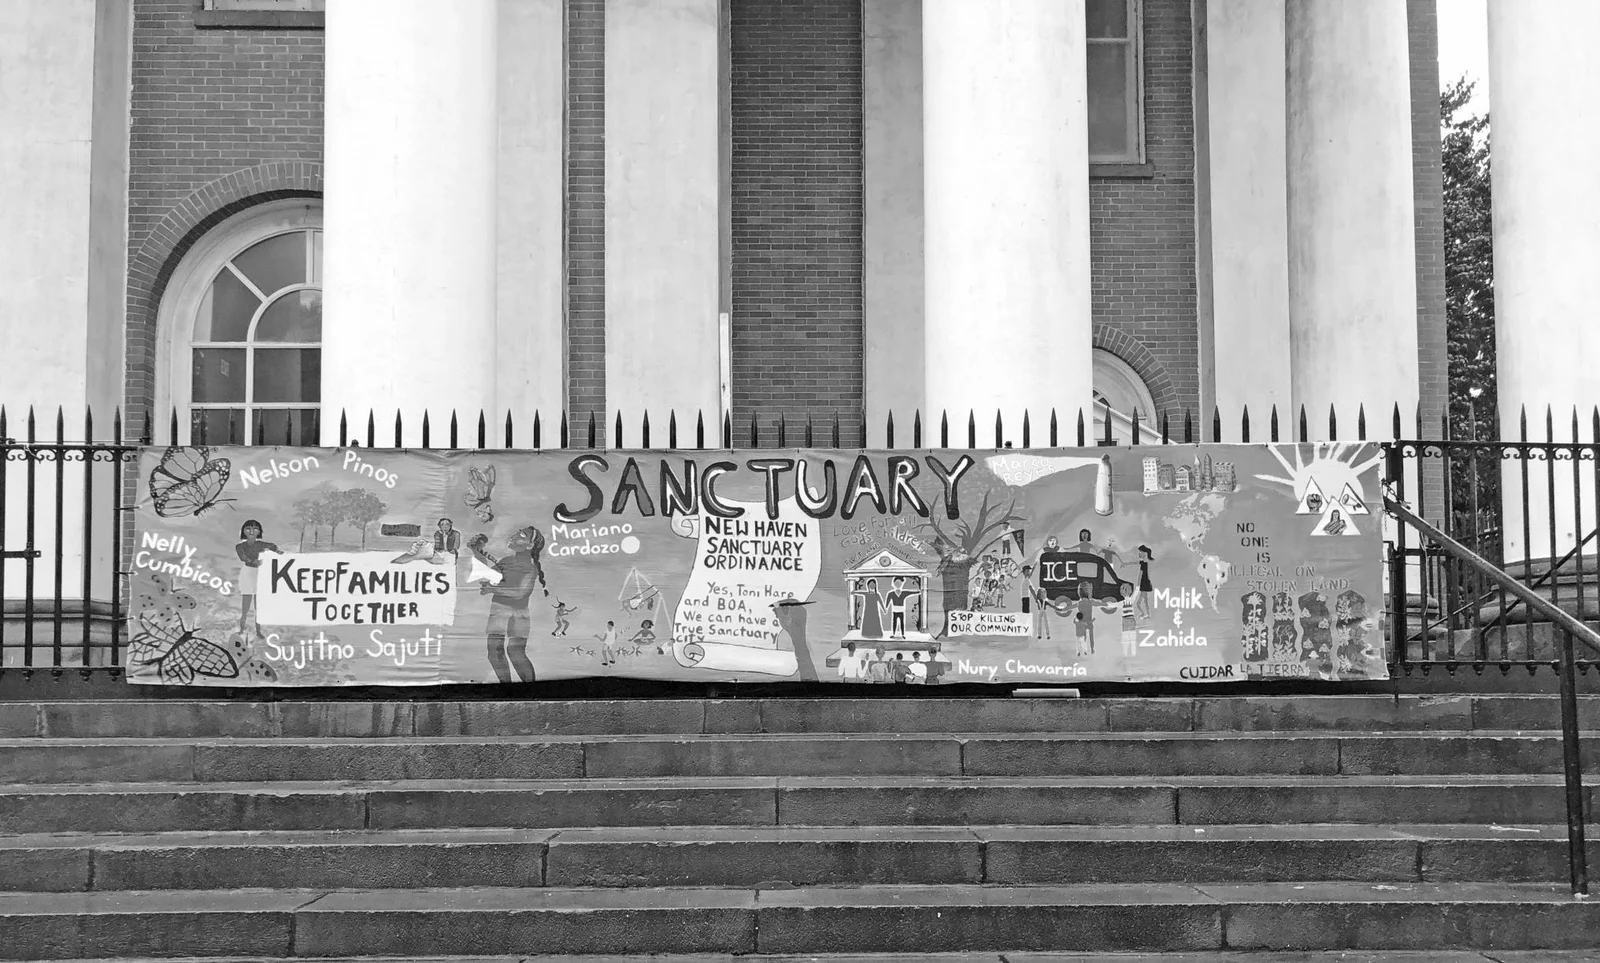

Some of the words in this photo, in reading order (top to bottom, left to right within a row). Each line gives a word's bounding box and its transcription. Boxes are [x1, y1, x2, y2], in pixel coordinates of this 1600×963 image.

[239, 455, 320, 489] Nelson
[343, 450, 399, 489] Pinos
[553, 454, 975, 523] SANCTUARY
[551, 523, 633, 541] Mariano
[705, 516, 748, 535] NEW
[754, 521, 807, 537] HAVEN
[1236, 522, 1255, 534] NO
[141, 532, 197, 565] Nelly
[548, 536, 620, 557] Cardozo
[707, 537, 803, 556] SANCTUARY
[1241, 537, 1269, 548] ONE
[704, 555, 803, 571] ORDINANCE
[1257, 552, 1271, 563] IS
[135, 551, 234, 596] Cumbicos
[1043, 561, 1078, 582] ICE
[1230, 565, 1283, 577] ILLEGAL
[1295, 566, 1315, 577] ON
[707, 582, 733, 597] Yes,
[737, 584, 760, 597] Toni
[765, 585, 794, 600] Harp
[1246, 580, 1297, 591] STOLEN
[1310, 579, 1349, 591] LAND
[684, 595, 709, 607] and
[717, 597, 752, 614] BOA,
[1153, 587, 1203, 609] Malik
[303, 597, 419, 624] TOGETHER
[683, 611, 702, 622] We
[708, 614, 732, 623] can
[739, 614, 766, 626] have
[951, 612, 973, 622] STOP
[980, 614, 1015, 623] KILLING
[1173, 608, 1183, 629] &
[675, 622, 703, 635] True
[708, 624, 778, 644] Sanctuary
[951, 623, 972, 633] OUR
[975, 624, 1030, 633] COMMUNITY
[1139, 627, 1208, 647] Zahida
[265, 631, 354, 669] Sujitno
[366, 629, 444, 666] Sajuti
[958, 659, 998, 681] Nury
[1006, 659, 1087, 676] Chavarría
[1180, 664, 1234, 679] CUIDAR
[1240, 663, 1252, 673] LA
[1259, 663, 1304, 676] TIERRA
